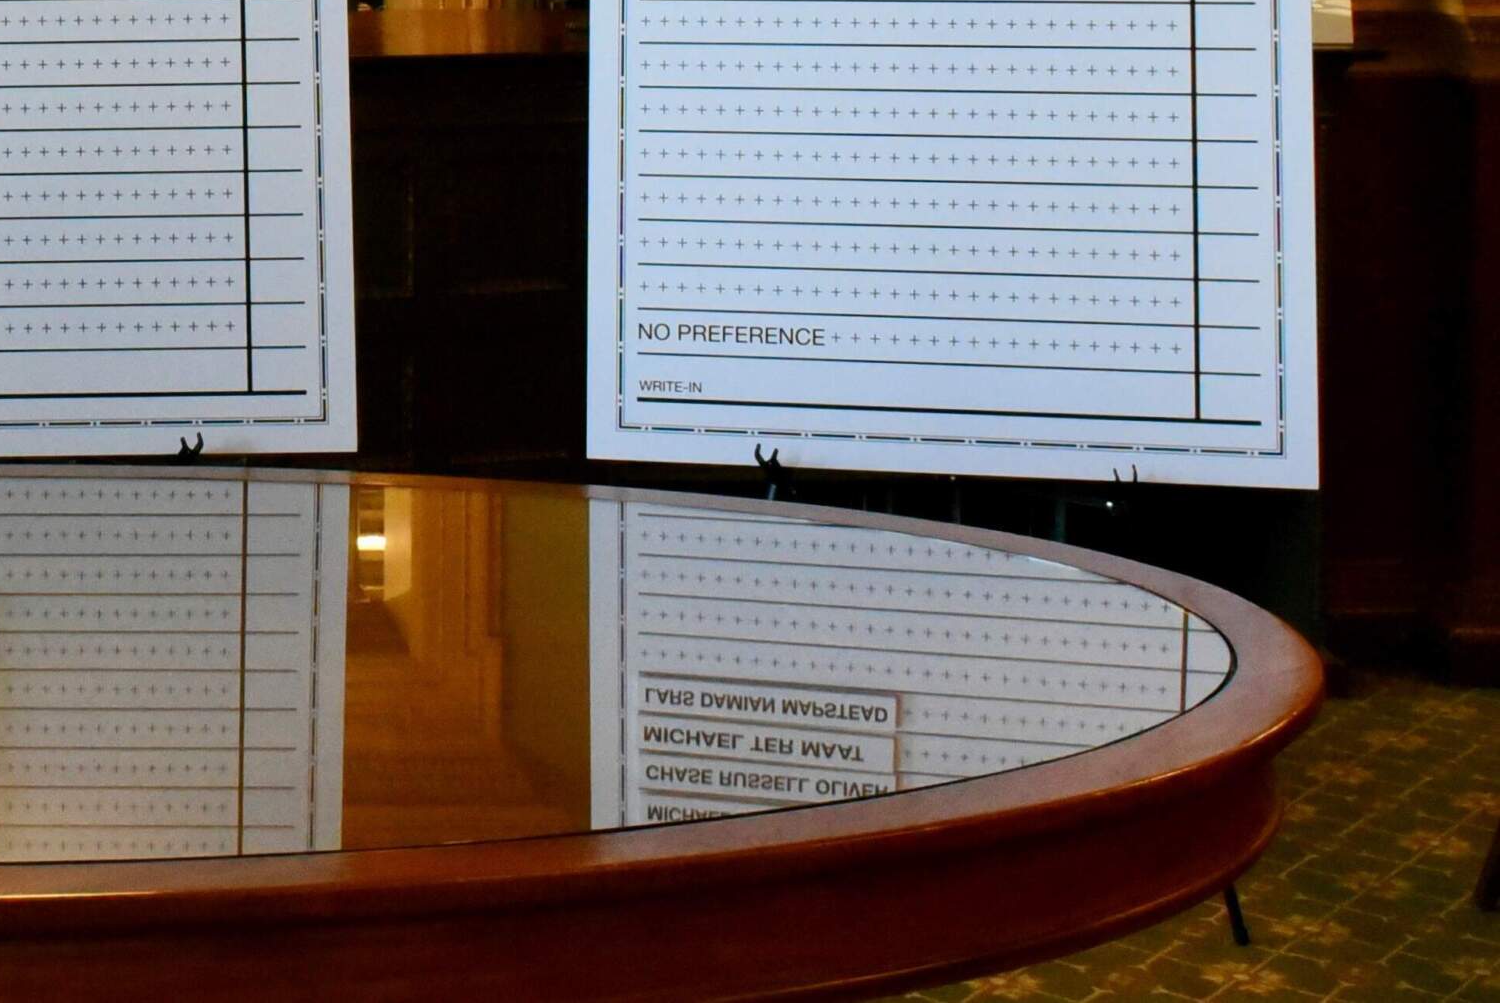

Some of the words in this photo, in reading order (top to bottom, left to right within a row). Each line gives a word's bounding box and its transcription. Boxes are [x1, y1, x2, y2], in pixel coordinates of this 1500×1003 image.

[638, 323, 671, 341] NO
[678, 324, 825, 346] PREFERENCE
[639, 380, 703, 393] WRITE-IN
